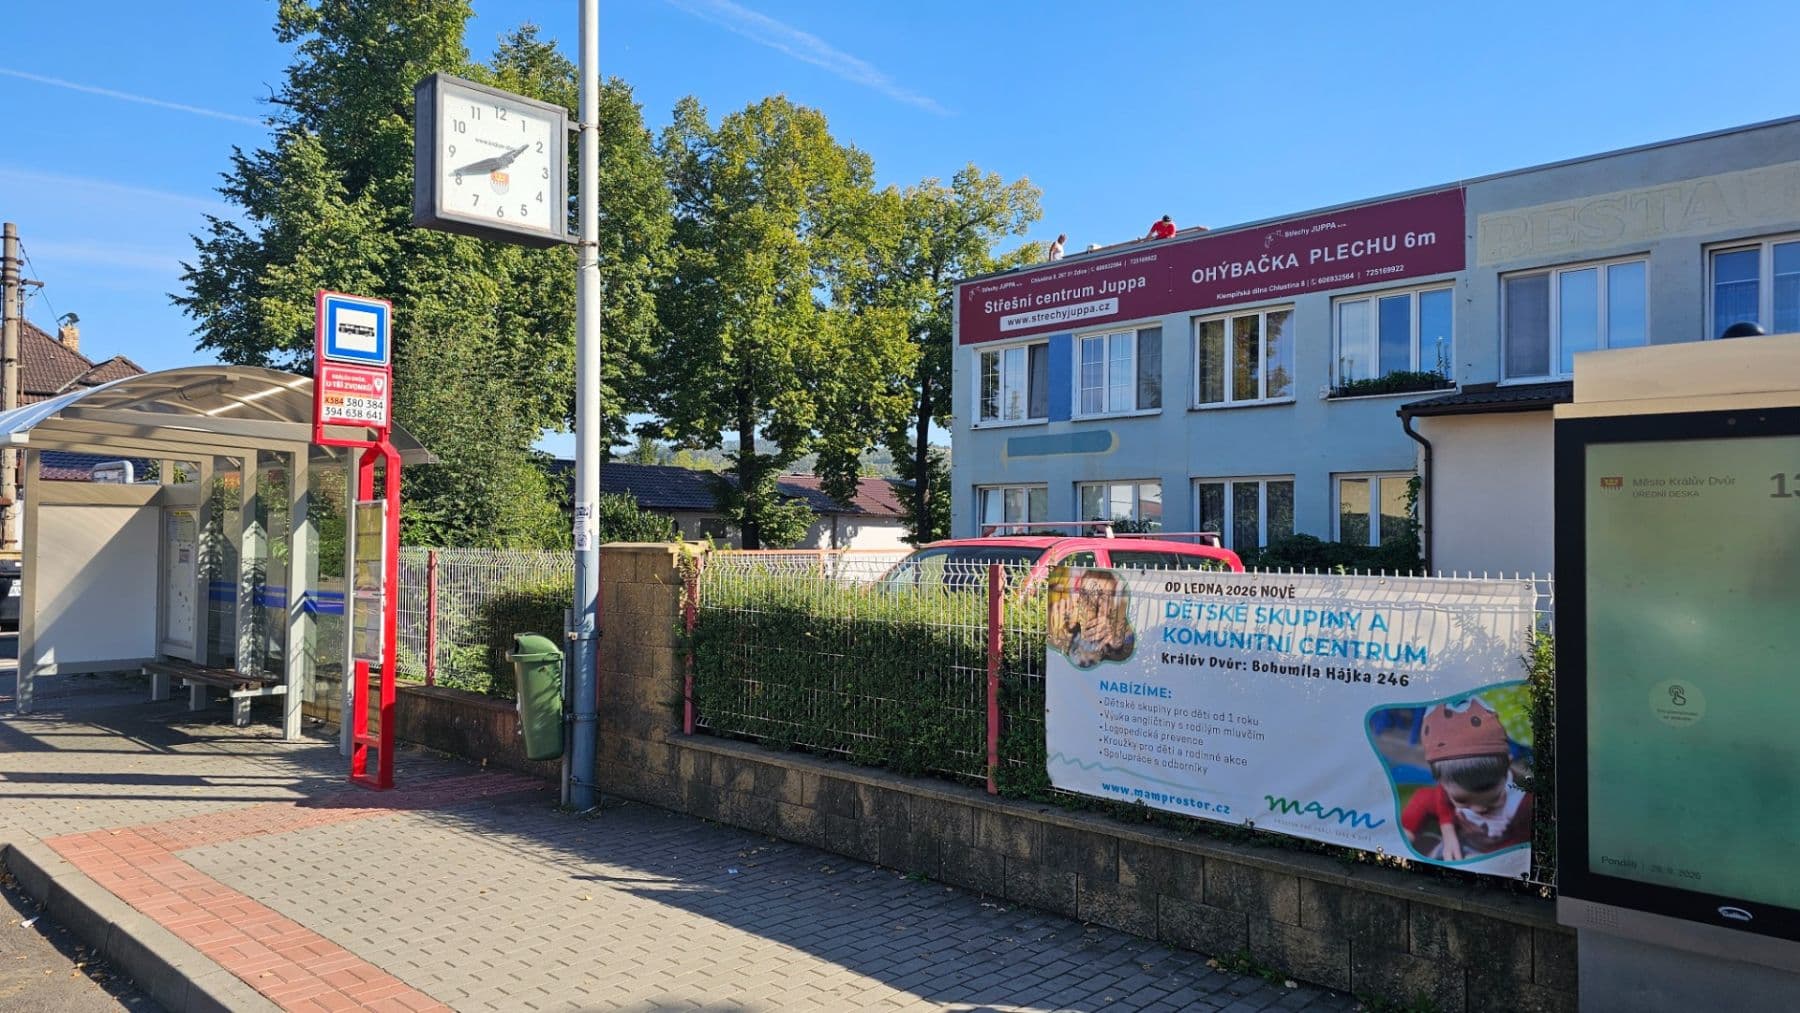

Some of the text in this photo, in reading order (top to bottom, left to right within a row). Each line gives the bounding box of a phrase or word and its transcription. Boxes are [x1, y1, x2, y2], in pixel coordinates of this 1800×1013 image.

[471, 106, 481, 120] 11
[495, 106, 507, 121] 12
[453, 119, 466, 134] 10
[521, 120, 526, 132] 1
[449, 145, 456, 158] 9
[535, 141, 543, 154] 2
[455, 173, 463, 186] 8
[542, 167, 549, 180] 3
[473, 194, 480, 207] 7
[535, 191, 543, 203] 4
[497, 206, 504, 218] 6
[520, 204, 528, 217] 5
[1311, 222, 1337, 233] JUPPA
[1191, 231, 1437, 284] OHÝBAČKA PLECHU 6m
[984, 276, 1146, 314] Střešní centrum Juppa
[1007, 302, 1111, 327] www.strechyjuppa.cz
[346, 398, 364, 408] 380
[366, 399, 384, 410] 384
[325, 407, 383, 421] 394 638 641
[1708, 475, 1736, 487] Dvůr
[1769, 472, 1800, 499] 1
[1165, 581, 1181, 593] OD
[1184, 583, 1223, 596] LEDNA
[1225, 585, 1257, 597] 2026
[1165, 599, 1389, 633] DĚTSKÉ SKUPINY A
[1163, 627, 1427, 665] KOMUNITNÍ CENTRUM
[1161, 652, 1410, 687] Králův Dvůr: Bohumila Hájka 246
[1100, 680, 1172, 699] NABÍZÍME:
[1103, 697, 1259, 726] Dětské skupiny pro děti od 1 roku
[1132, 716, 1176, 730] angličtiny
[1224, 727, 1265, 741] mluvčím
[1161, 733, 1204, 746] prevence
[1140, 742, 1154, 752] pro
[1157, 744, 1175, 755] děti
[1224, 754, 1248, 767] akce
[1162, 758, 1208, 775] odborníky
[1102, 782, 1232, 815] www.mamprostor.cz
[1264, 795, 1386, 829] mam
